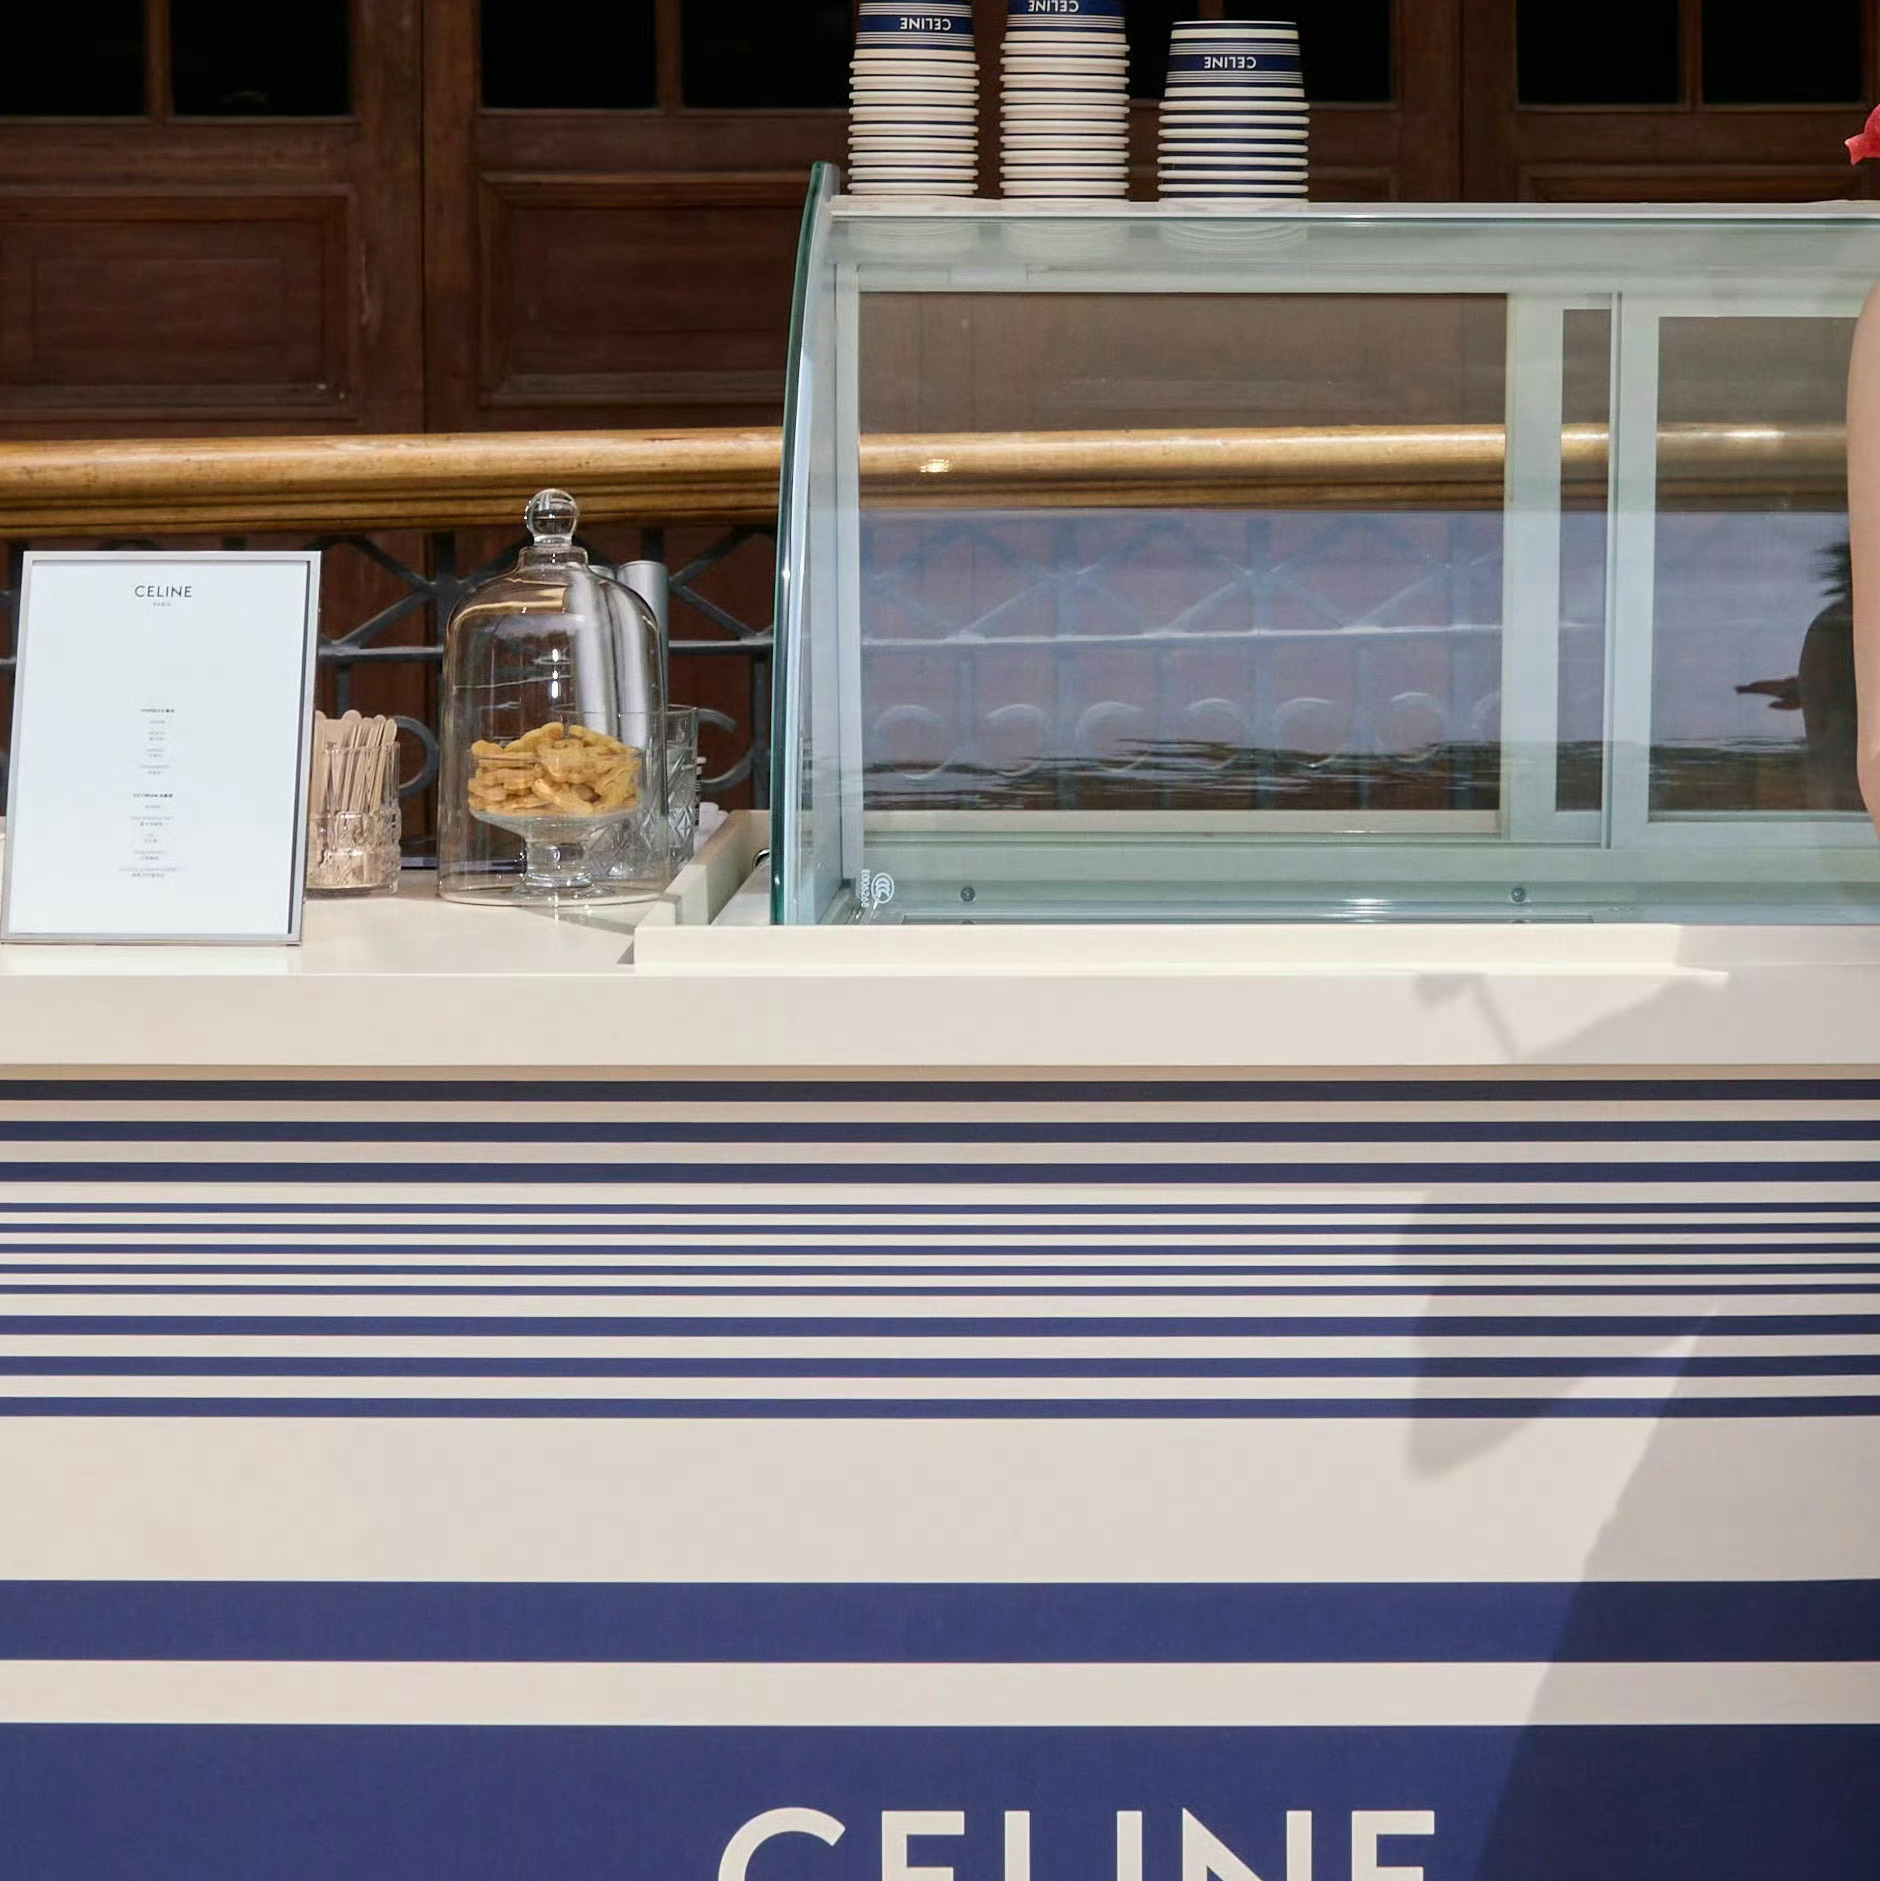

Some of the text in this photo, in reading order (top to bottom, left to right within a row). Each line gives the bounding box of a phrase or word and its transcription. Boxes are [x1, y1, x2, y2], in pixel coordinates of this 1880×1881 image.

[1028, 0, 1080, 13] CELINE
[899, 17, 952, 31] CELINE
[1203, 56, 1257, 69] CELINE
[134, 585, 193, 598] CELINE
